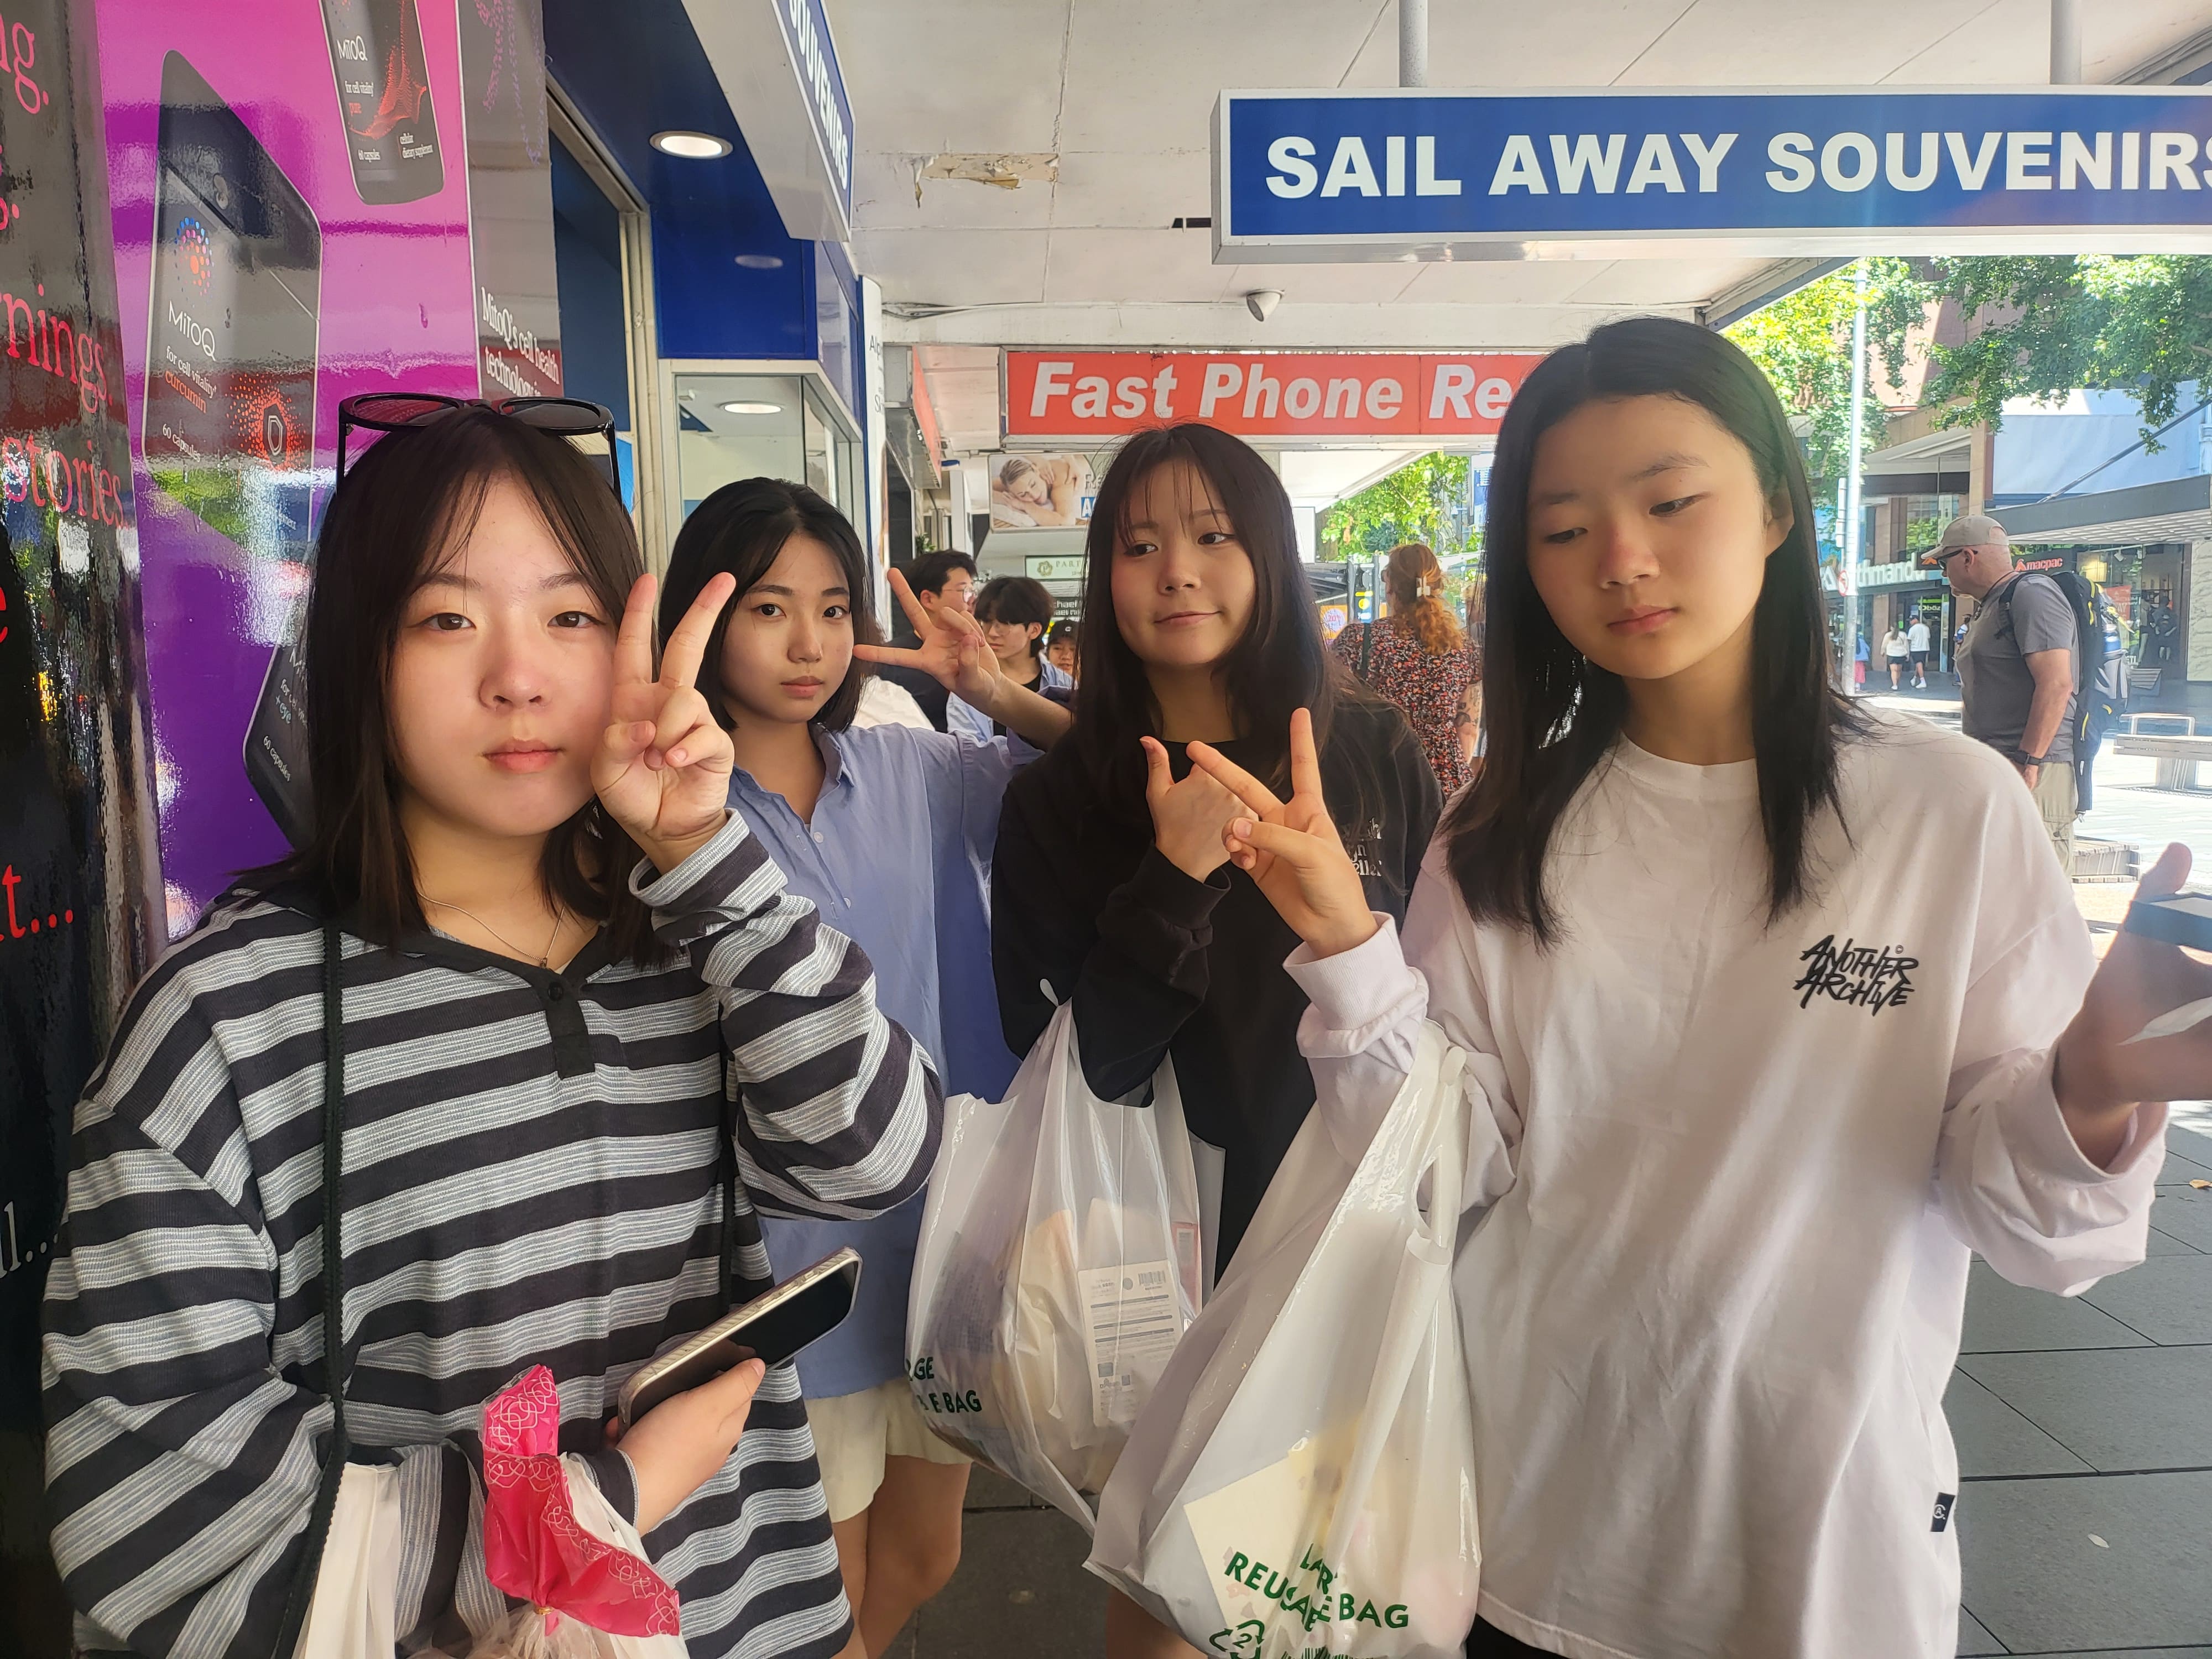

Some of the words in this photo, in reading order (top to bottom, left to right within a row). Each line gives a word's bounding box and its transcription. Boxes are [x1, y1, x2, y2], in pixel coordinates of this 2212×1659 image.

[1266, 136, 1461, 199] SAIL
[1488, 133, 1739, 195] AWAY
[166, 345, 178, 364] for
[178, 359, 190, 377] cell
[519, 331, 534, 363] cell
[534, 337, 560, 384] health
[165, 371, 206, 414] curcumin
[1030, 361, 1178, 419] Fast
[1198, 362, 1403, 420] Phone
[1428, 364, 1524, 419] Re
[163, 424, 171, 440] 60
[173, 434, 201, 462] capsules
[2026, 557, 2063, 571] macpac
[263, 735, 271, 750] 60
[270, 748, 291, 782] capsules
[1799, 935, 1919, 984] ANOTHER
[1792, 958, 1915, 1016] ARCHIVE
[942, 1390, 982, 1414] BAG
[1339, 1593, 1408, 1629] BAG
